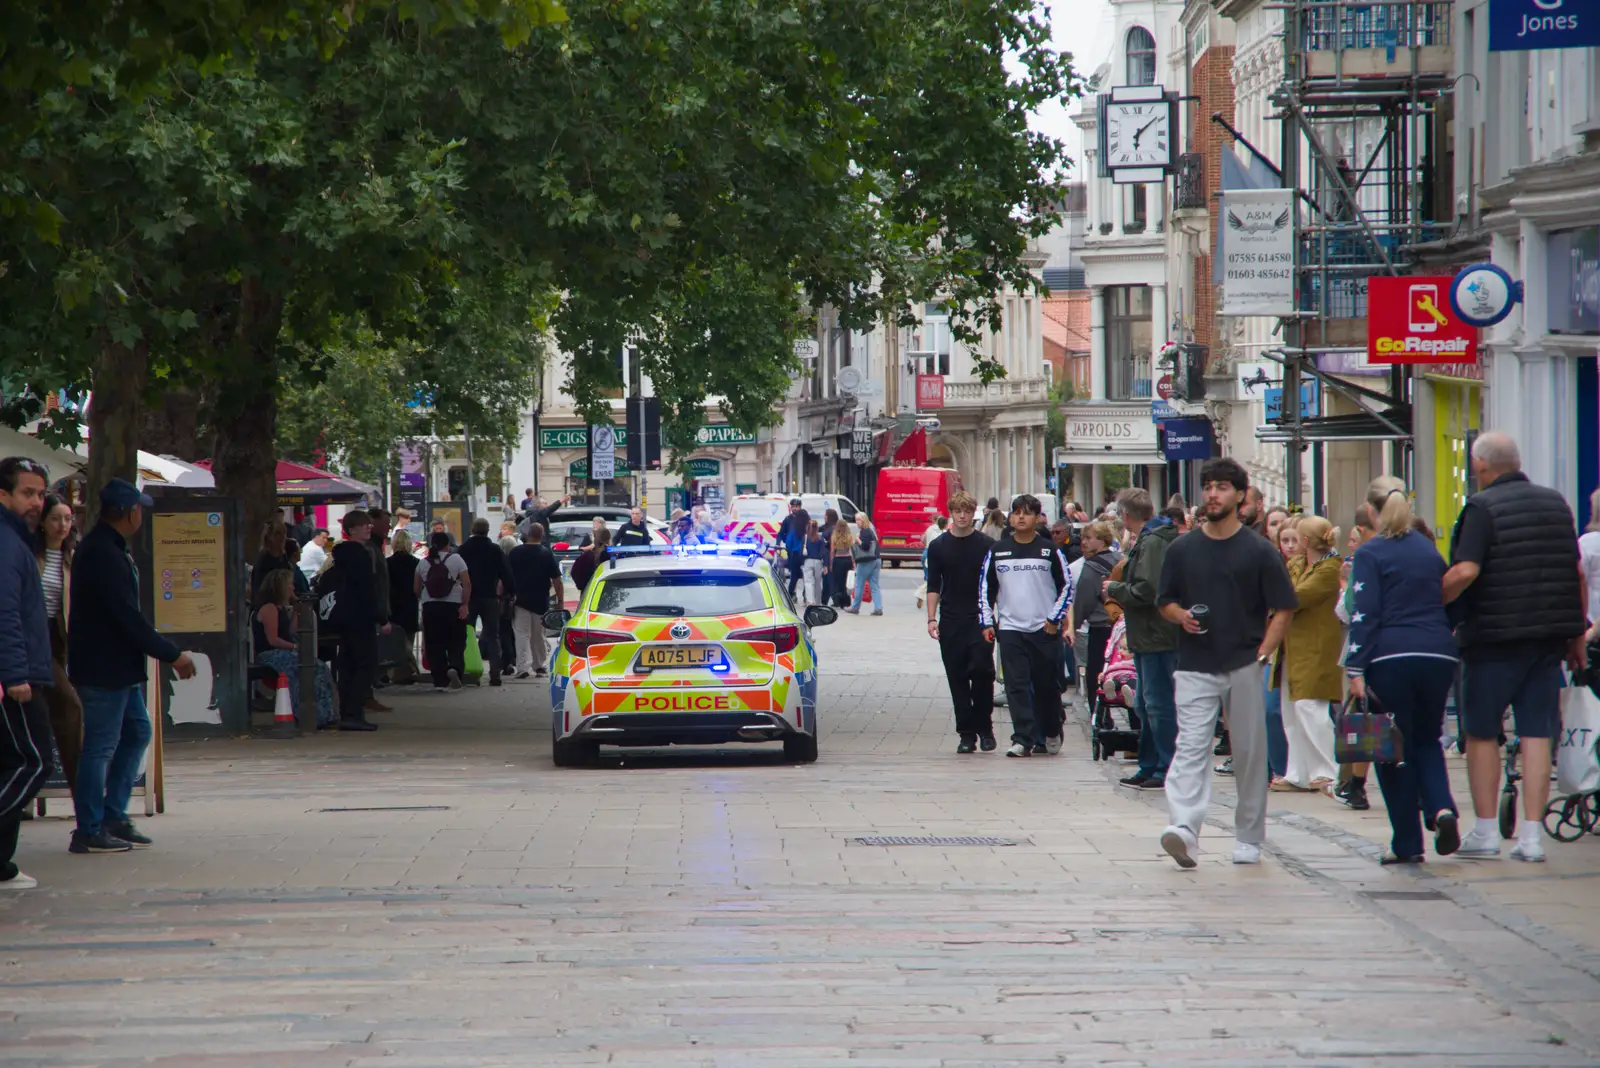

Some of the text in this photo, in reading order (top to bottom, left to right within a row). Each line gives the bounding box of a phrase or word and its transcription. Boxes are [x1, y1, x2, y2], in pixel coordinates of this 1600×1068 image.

[1516, 13, 1579, 37] Jones
[1245, 211, 1272, 221] A&M
[1228, 252, 1292, 264] 07585 614580
[1227, 269, 1290, 280] 01603 485642
[1375, 336, 1470, 356] GoRepair
[1072, 422, 1132, 437] JARROLDS
[543, 431, 587, 445] E-CIGS
[852, 431, 871, 443] WE
[1167, 435, 1204, 443] co-operative
[852, 443, 871, 452] BUY
[852, 452, 872, 460] GOLD
[895, 459, 916, 467] SALE
[1012, 564, 1049, 572] SUBARU
[688, 649, 716, 663] LJF
[634, 695, 729, 711] POLICE
